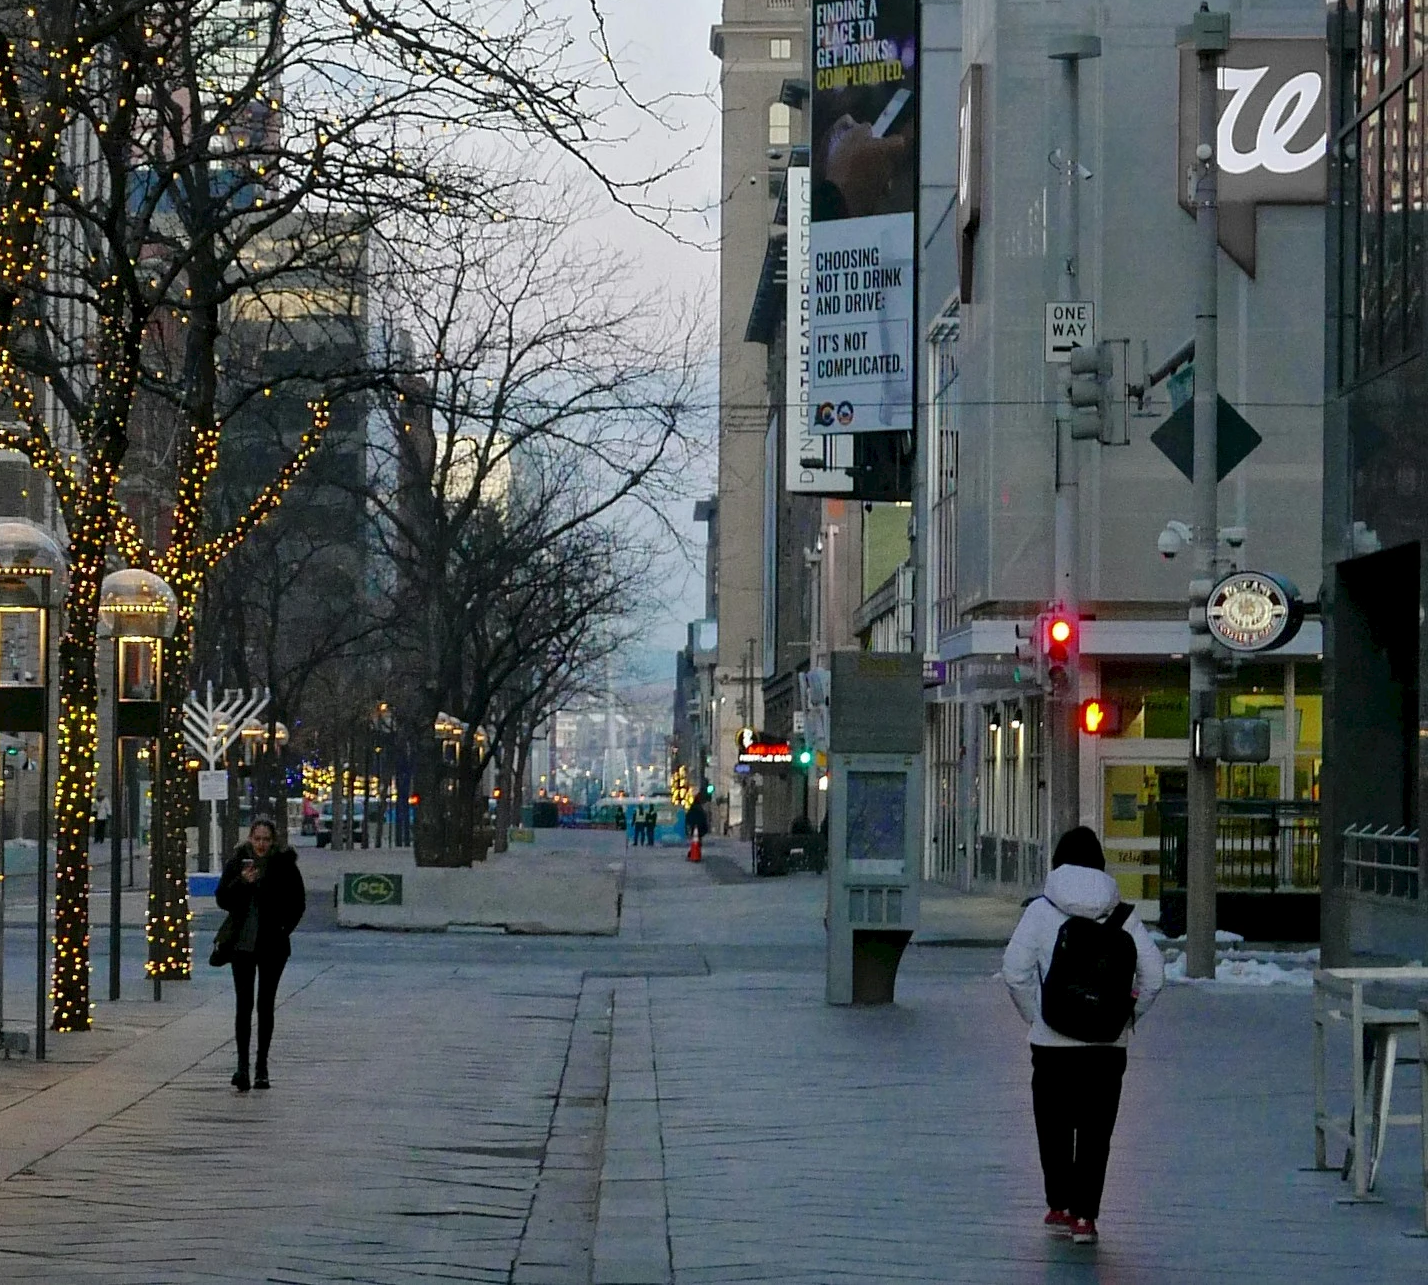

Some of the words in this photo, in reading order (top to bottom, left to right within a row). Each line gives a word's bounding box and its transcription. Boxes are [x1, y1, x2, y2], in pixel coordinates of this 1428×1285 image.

[816, 24, 855, 47] PLACE
[859, 19, 875, 41] TO
[816, 46, 840, 69] GET
[842, 41, 893, 65] DRINKS:
[817, 60, 904, 90] COMPLICATED.
[815, 247, 879, 272] CHOOSING
[815, 272, 839, 294] NOT
[842, 270, 859, 292] TO
[863, 267, 902, 289] DRINK
[815, 294, 840, 316] AND
[845, 291, 886, 313] DRIVE:
[1053, 306, 1087, 321] ONE
[1052, 322, 1088, 337] WAY
[817, 333, 839, 354] IT'S
[843, 331, 868, 351] NOT
[817, 354, 904, 379] COMPLICATED.
[357, 882, 388, 895] PCL
